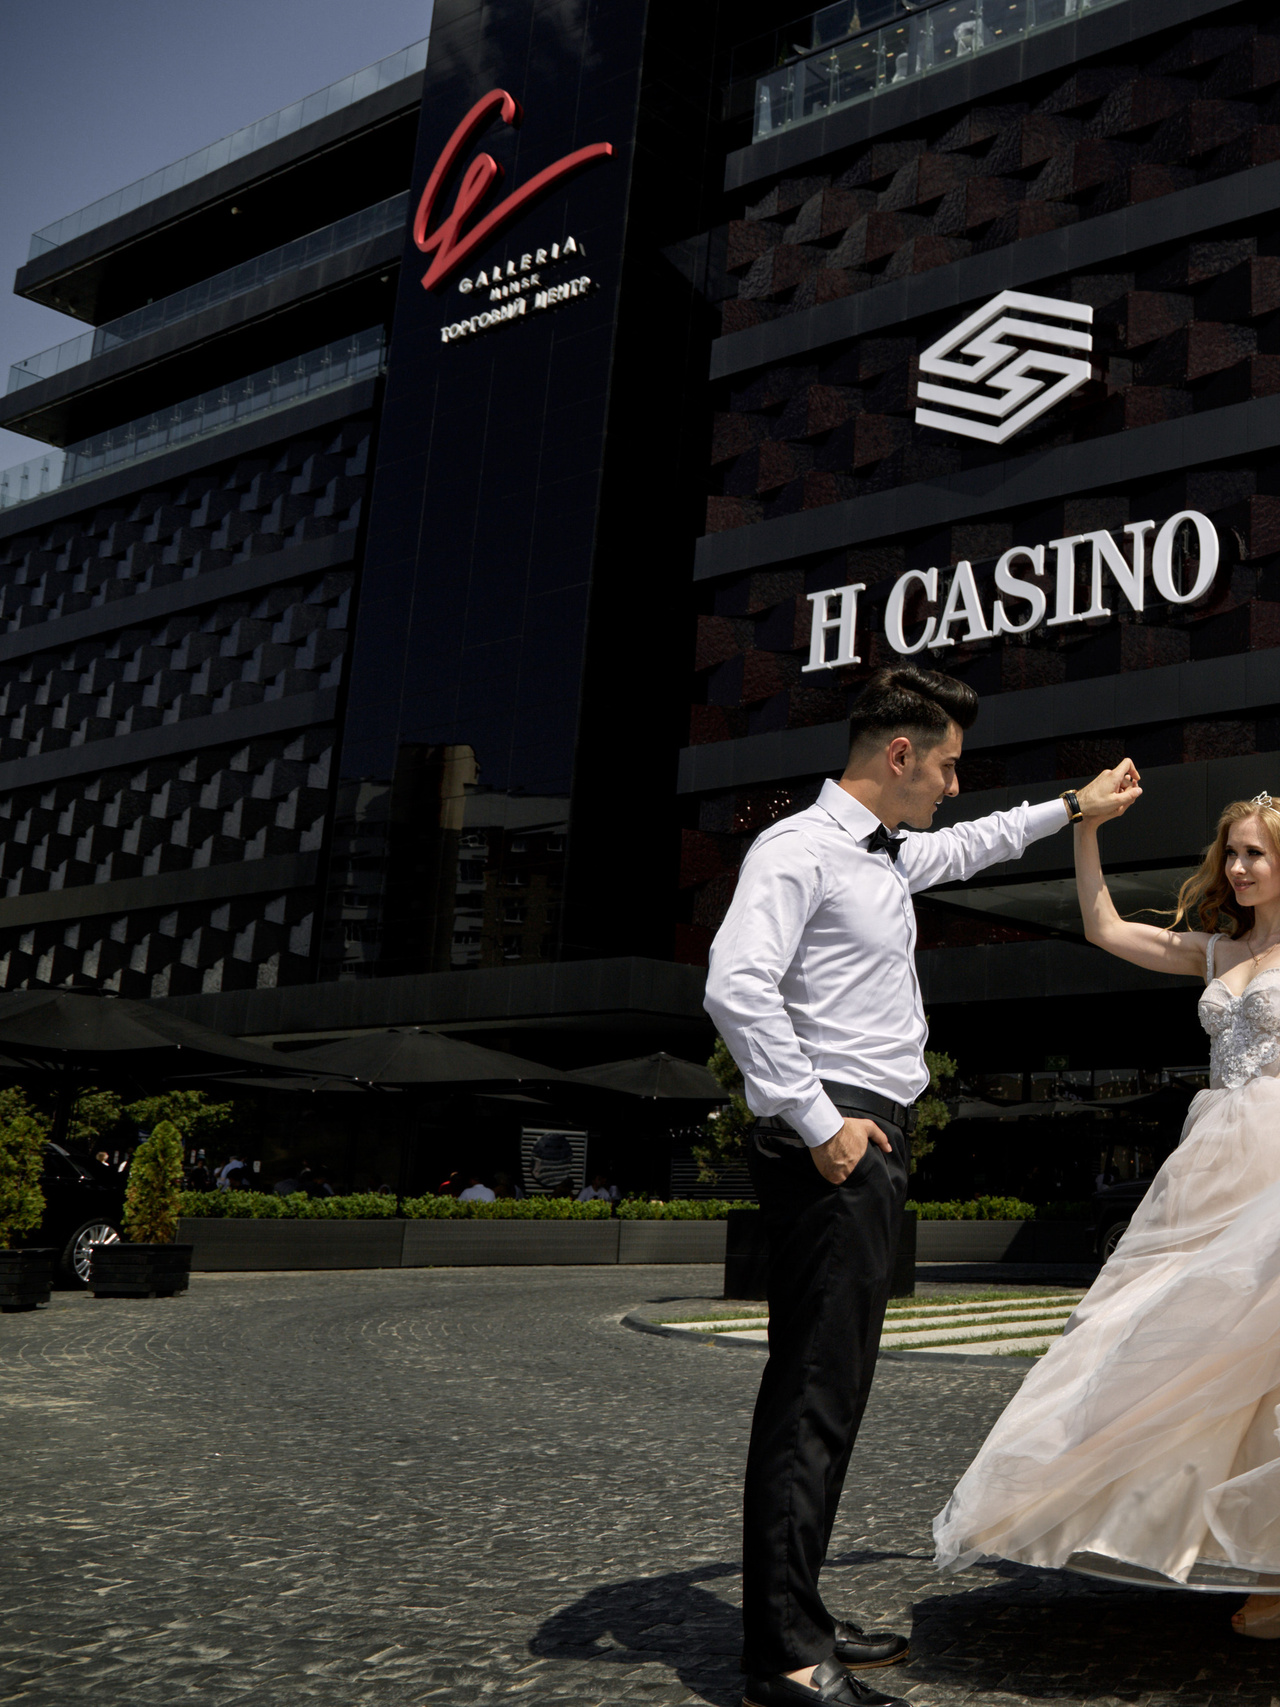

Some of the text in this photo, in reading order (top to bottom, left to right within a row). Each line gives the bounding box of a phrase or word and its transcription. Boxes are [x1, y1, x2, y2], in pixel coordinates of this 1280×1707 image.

[458, 235, 578, 293] GALLERIA
[489, 273, 541, 301] MINSK
[440, 275, 592, 343] ТОРГОВЫЙ ЦЕНТР
[801, 509, 1220, 673] H CASINO
